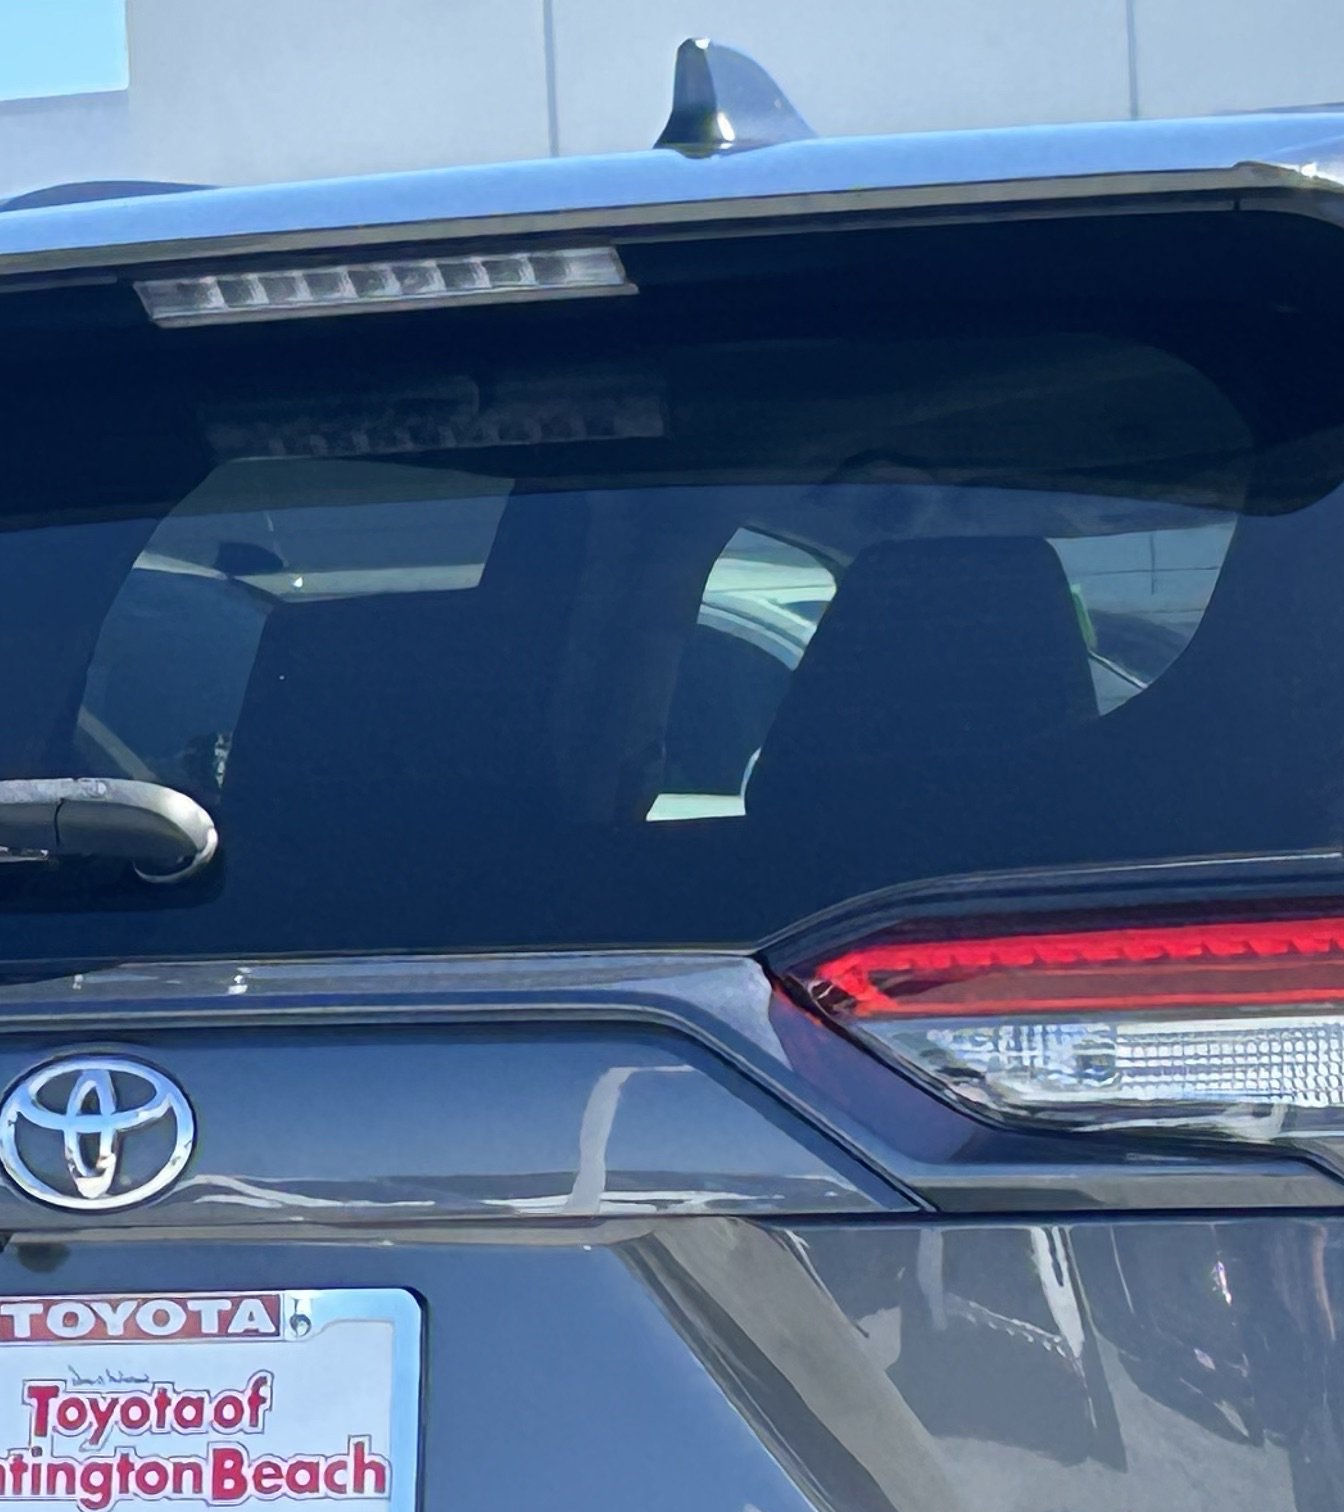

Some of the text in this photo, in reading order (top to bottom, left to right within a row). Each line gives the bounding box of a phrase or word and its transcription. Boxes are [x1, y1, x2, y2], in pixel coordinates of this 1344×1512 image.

[27, 1375, 268, 1445] Toyota of
[207, 1438, 387, 1502] Beach
